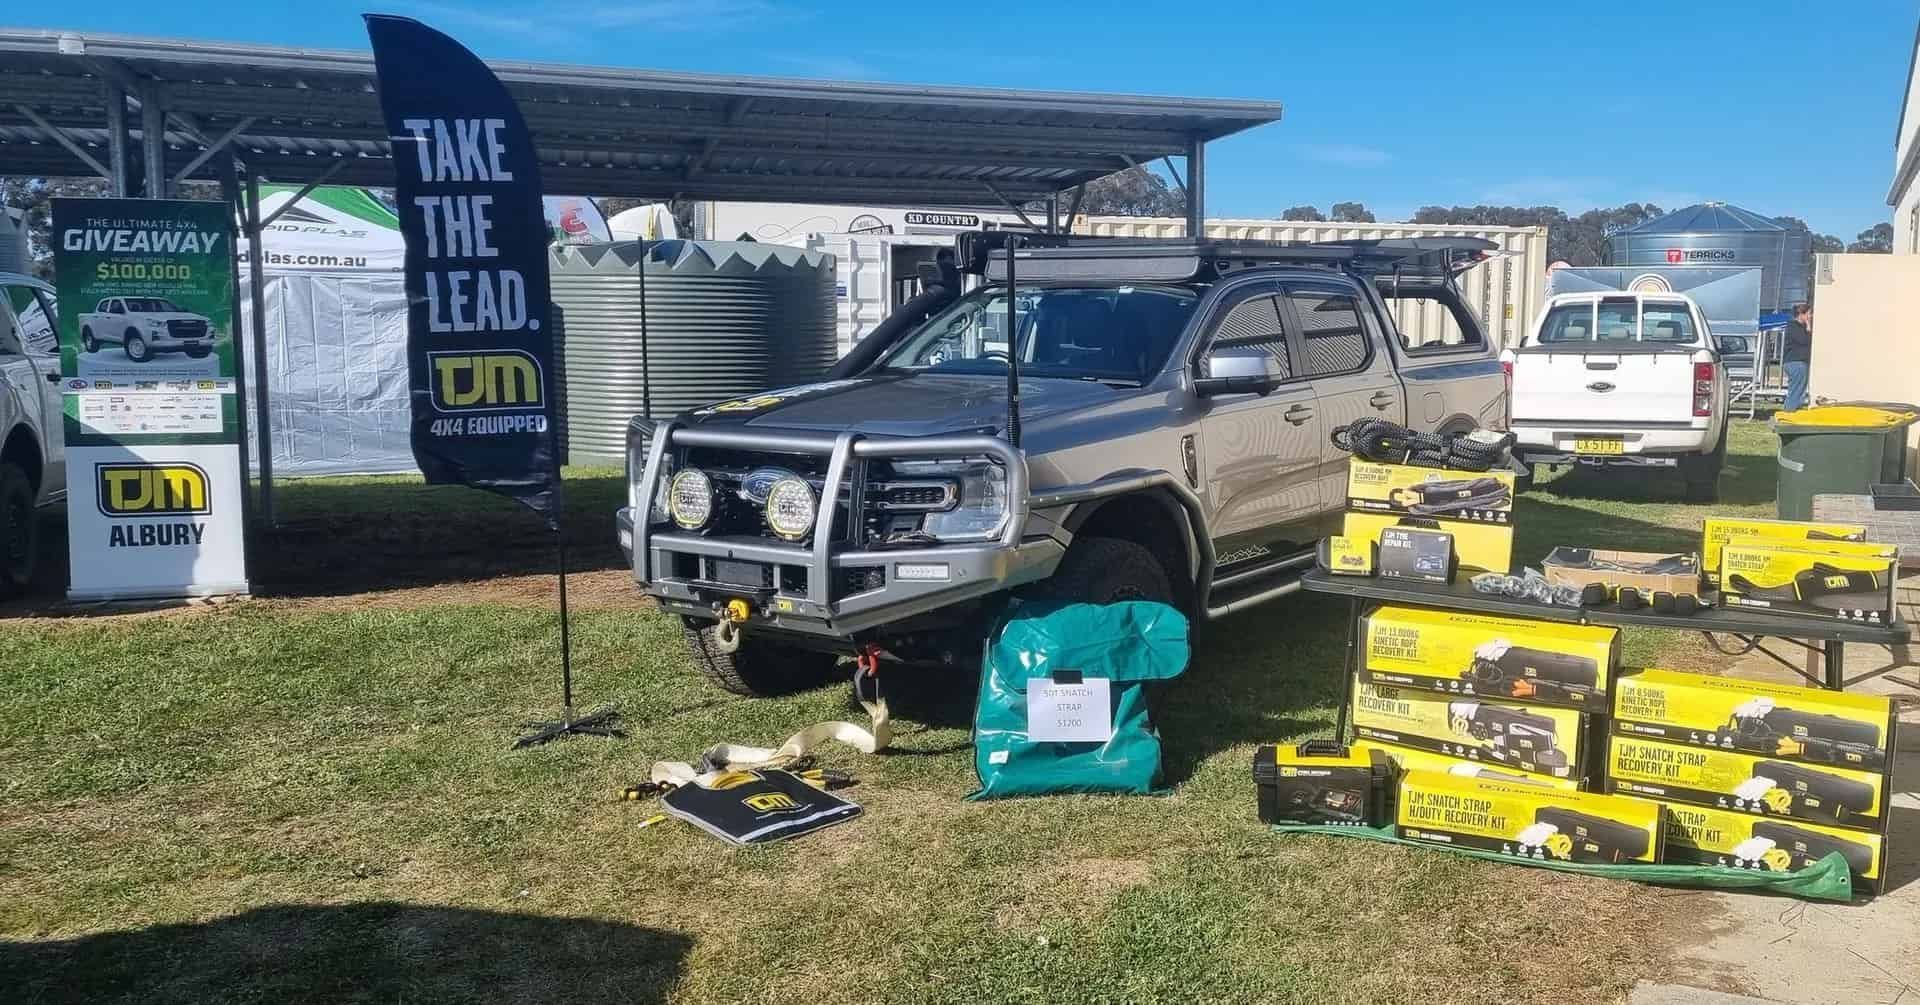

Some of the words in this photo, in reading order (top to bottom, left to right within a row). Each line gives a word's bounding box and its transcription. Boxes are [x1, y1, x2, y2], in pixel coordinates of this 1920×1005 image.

[403, 118, 513, 182] TAKE
[87, 218, 112, 228] THE
[113, 219, 172, 229] ULTIMATE
[414, 196, 498, 258] THE
[908, 213, 923, 223] KD
[926, 214, 977, 225] COUNTRY
[63, 229, 220, 254] GIVEAWAY
[1684, 250, 1735, 259] TERRICKS
[97, 262, 191, 280] $100,000
[425, 269, 540, 333] LEAD.
[434, 355, 539, 406] TJM
[431, 417, 464, 437] 4X4
[467, 415, 548, 435] EQUIPPED
[103, 469, 204, 510] TJM
[109, 523, 206, 547] ALBURY
[1061, 688, 1093, 697] SNATCH
[1377, 685, 1400, 699] LARGE
[1056, 703, 1082, 712] STRAP
[1359, 696, 1396, 712] RECOVERY
[1398, 702, 1410, 715] KIT
[1621, 704, 1653, 716] RECOVERY
[1654, 708, 1666, 718] KIT
[1619, 743, 1636, 758] TJM
[1639, 747, 1673, 763] SNATCH
[1676, 752, 1706, 767] STRAP
[1617, 757, 1662, 775] RECOVERY
[1665, 765, 1680, 777] KIT
[1408, 790, 1424, 805] TJM
[1427, 793, 1460, 810] SNATCH
[1463, 798, 1492, 814] STRAP
[1409, 804, 1442, 820] H/DUTY
[1445, 809, 1489, 828] RECOVERY
[1491, 816, 1507, 830] KIT
[1677, 811, 1706, 826] STRAP
[1706, 829, 1721, 843] KIT
